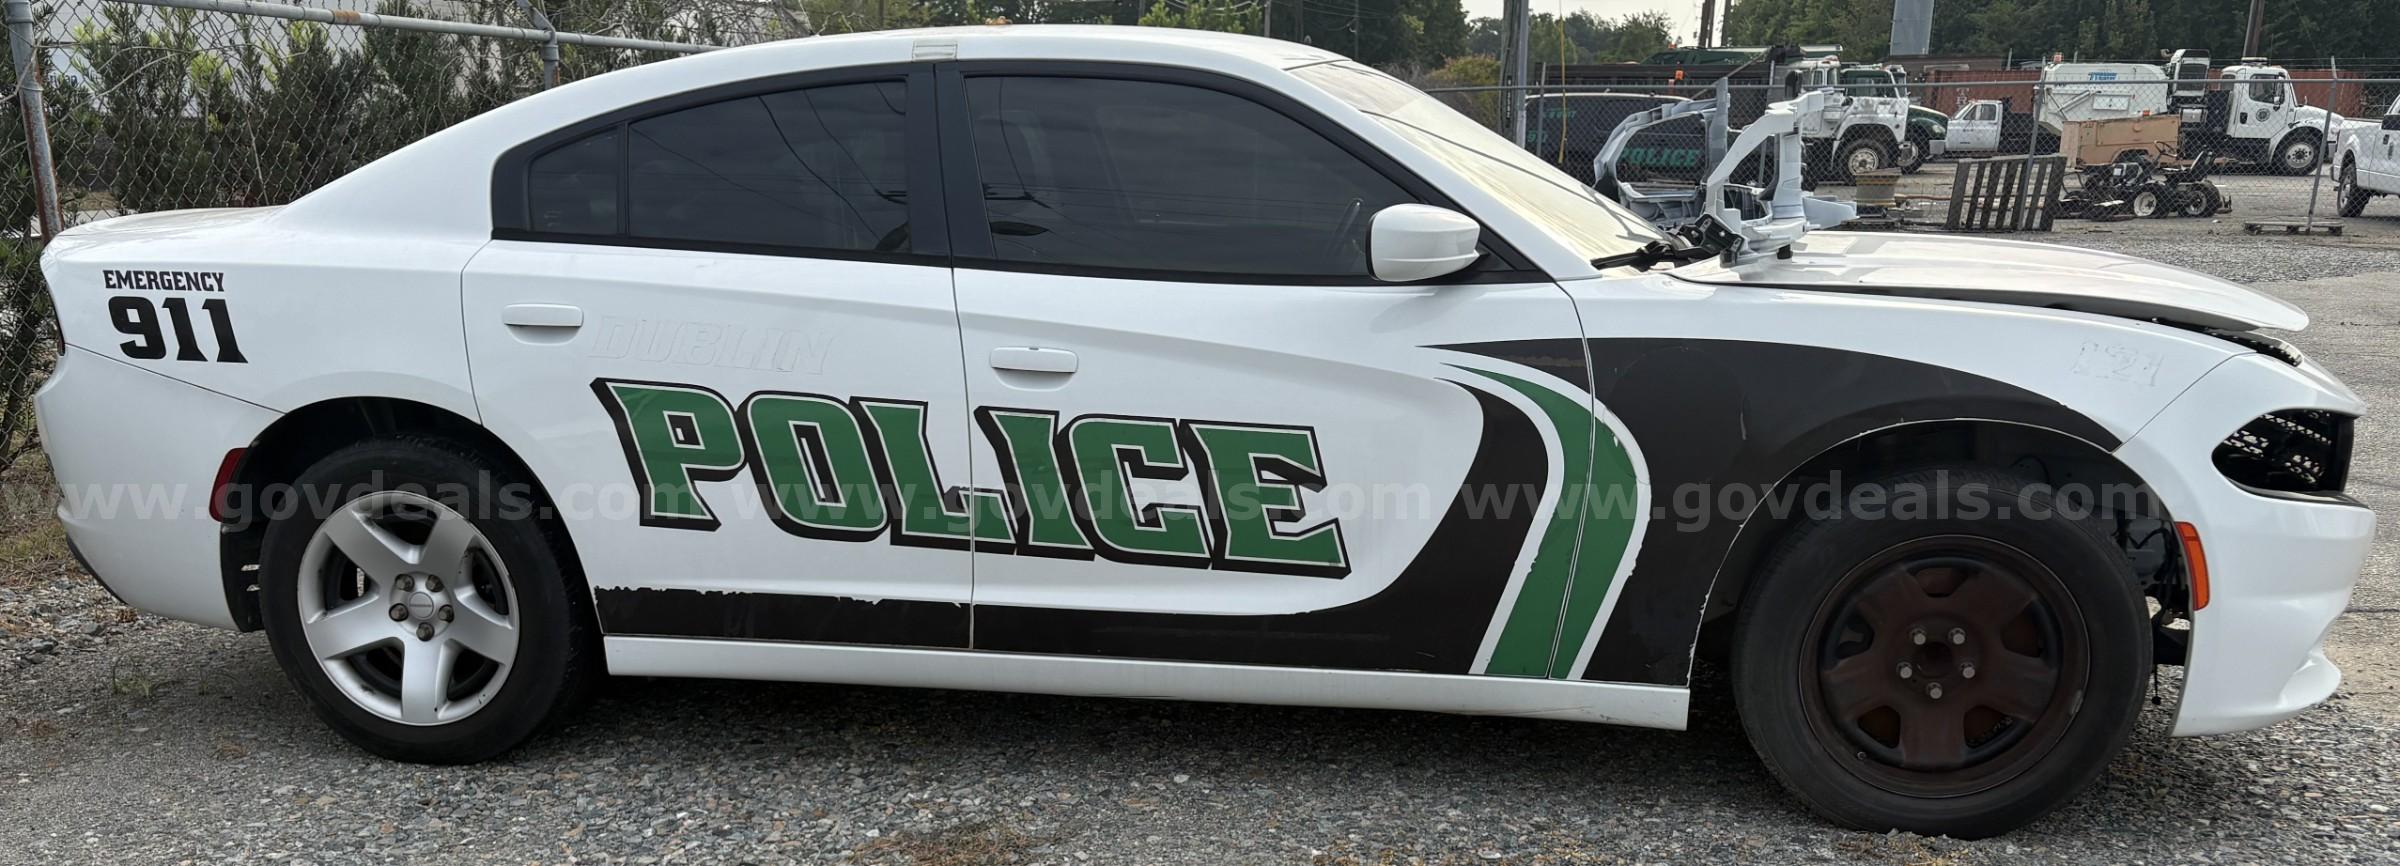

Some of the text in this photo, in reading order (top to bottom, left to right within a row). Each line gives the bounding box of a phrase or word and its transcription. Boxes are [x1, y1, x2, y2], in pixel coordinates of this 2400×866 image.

[102, 270, 225, 292] EMERGENCY
[108, 296, 249, 363] 911
[587, 315, 836, 375] DUBLIN
[590, 378, 1352, 580] POLICE
